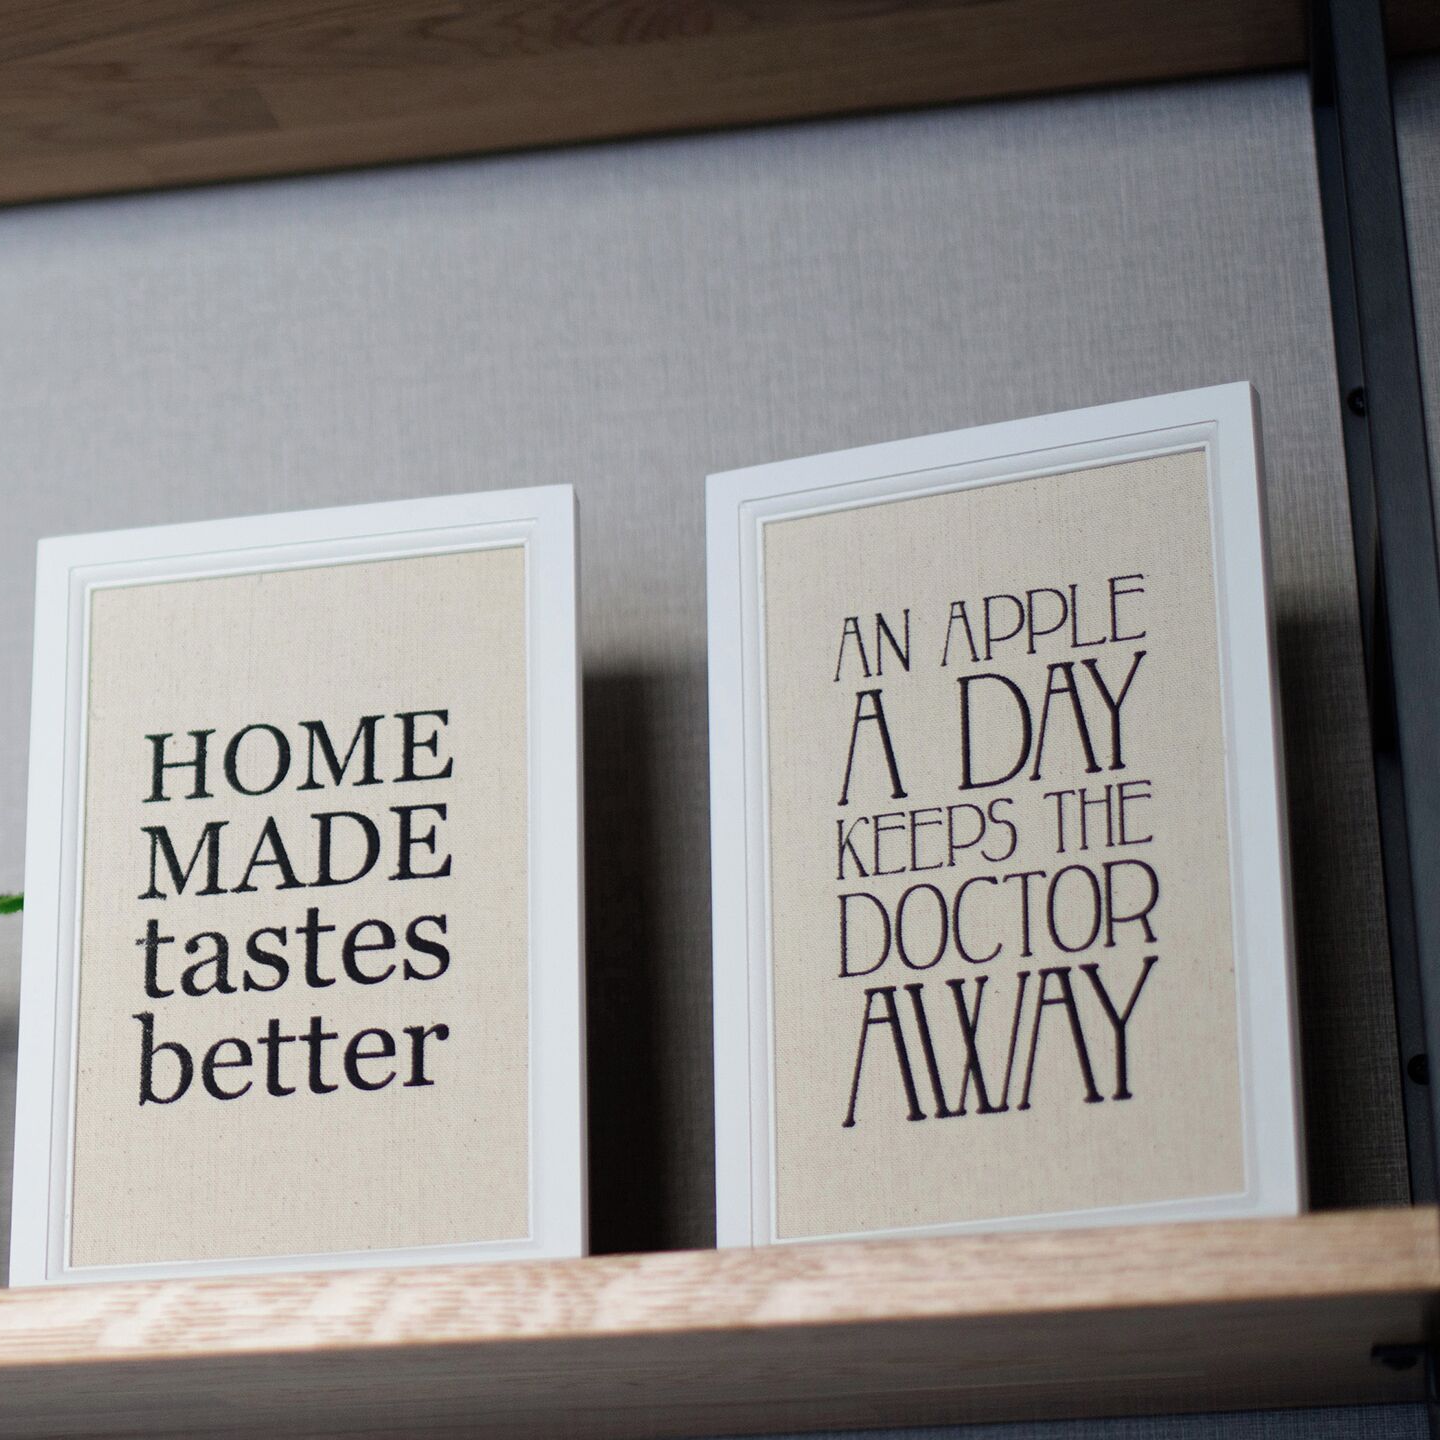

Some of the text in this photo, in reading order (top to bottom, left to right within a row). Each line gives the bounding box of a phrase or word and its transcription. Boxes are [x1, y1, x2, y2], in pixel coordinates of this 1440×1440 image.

[833, 573, 1147, 682] AN APPLE
[142, 709, 453, 803] HOME
[837, 650, 1147, 806] A DAY
[137, 803, 452, 900] MADE
[836, 780, 1154, 880] KEEPS THE
[135, 907, 451, 999] tastes
[837, 858, 1160, 978] DOCTOR
[131, 1011, 450, 1107] better
[842, 955, 1159, 1128] AWAY
